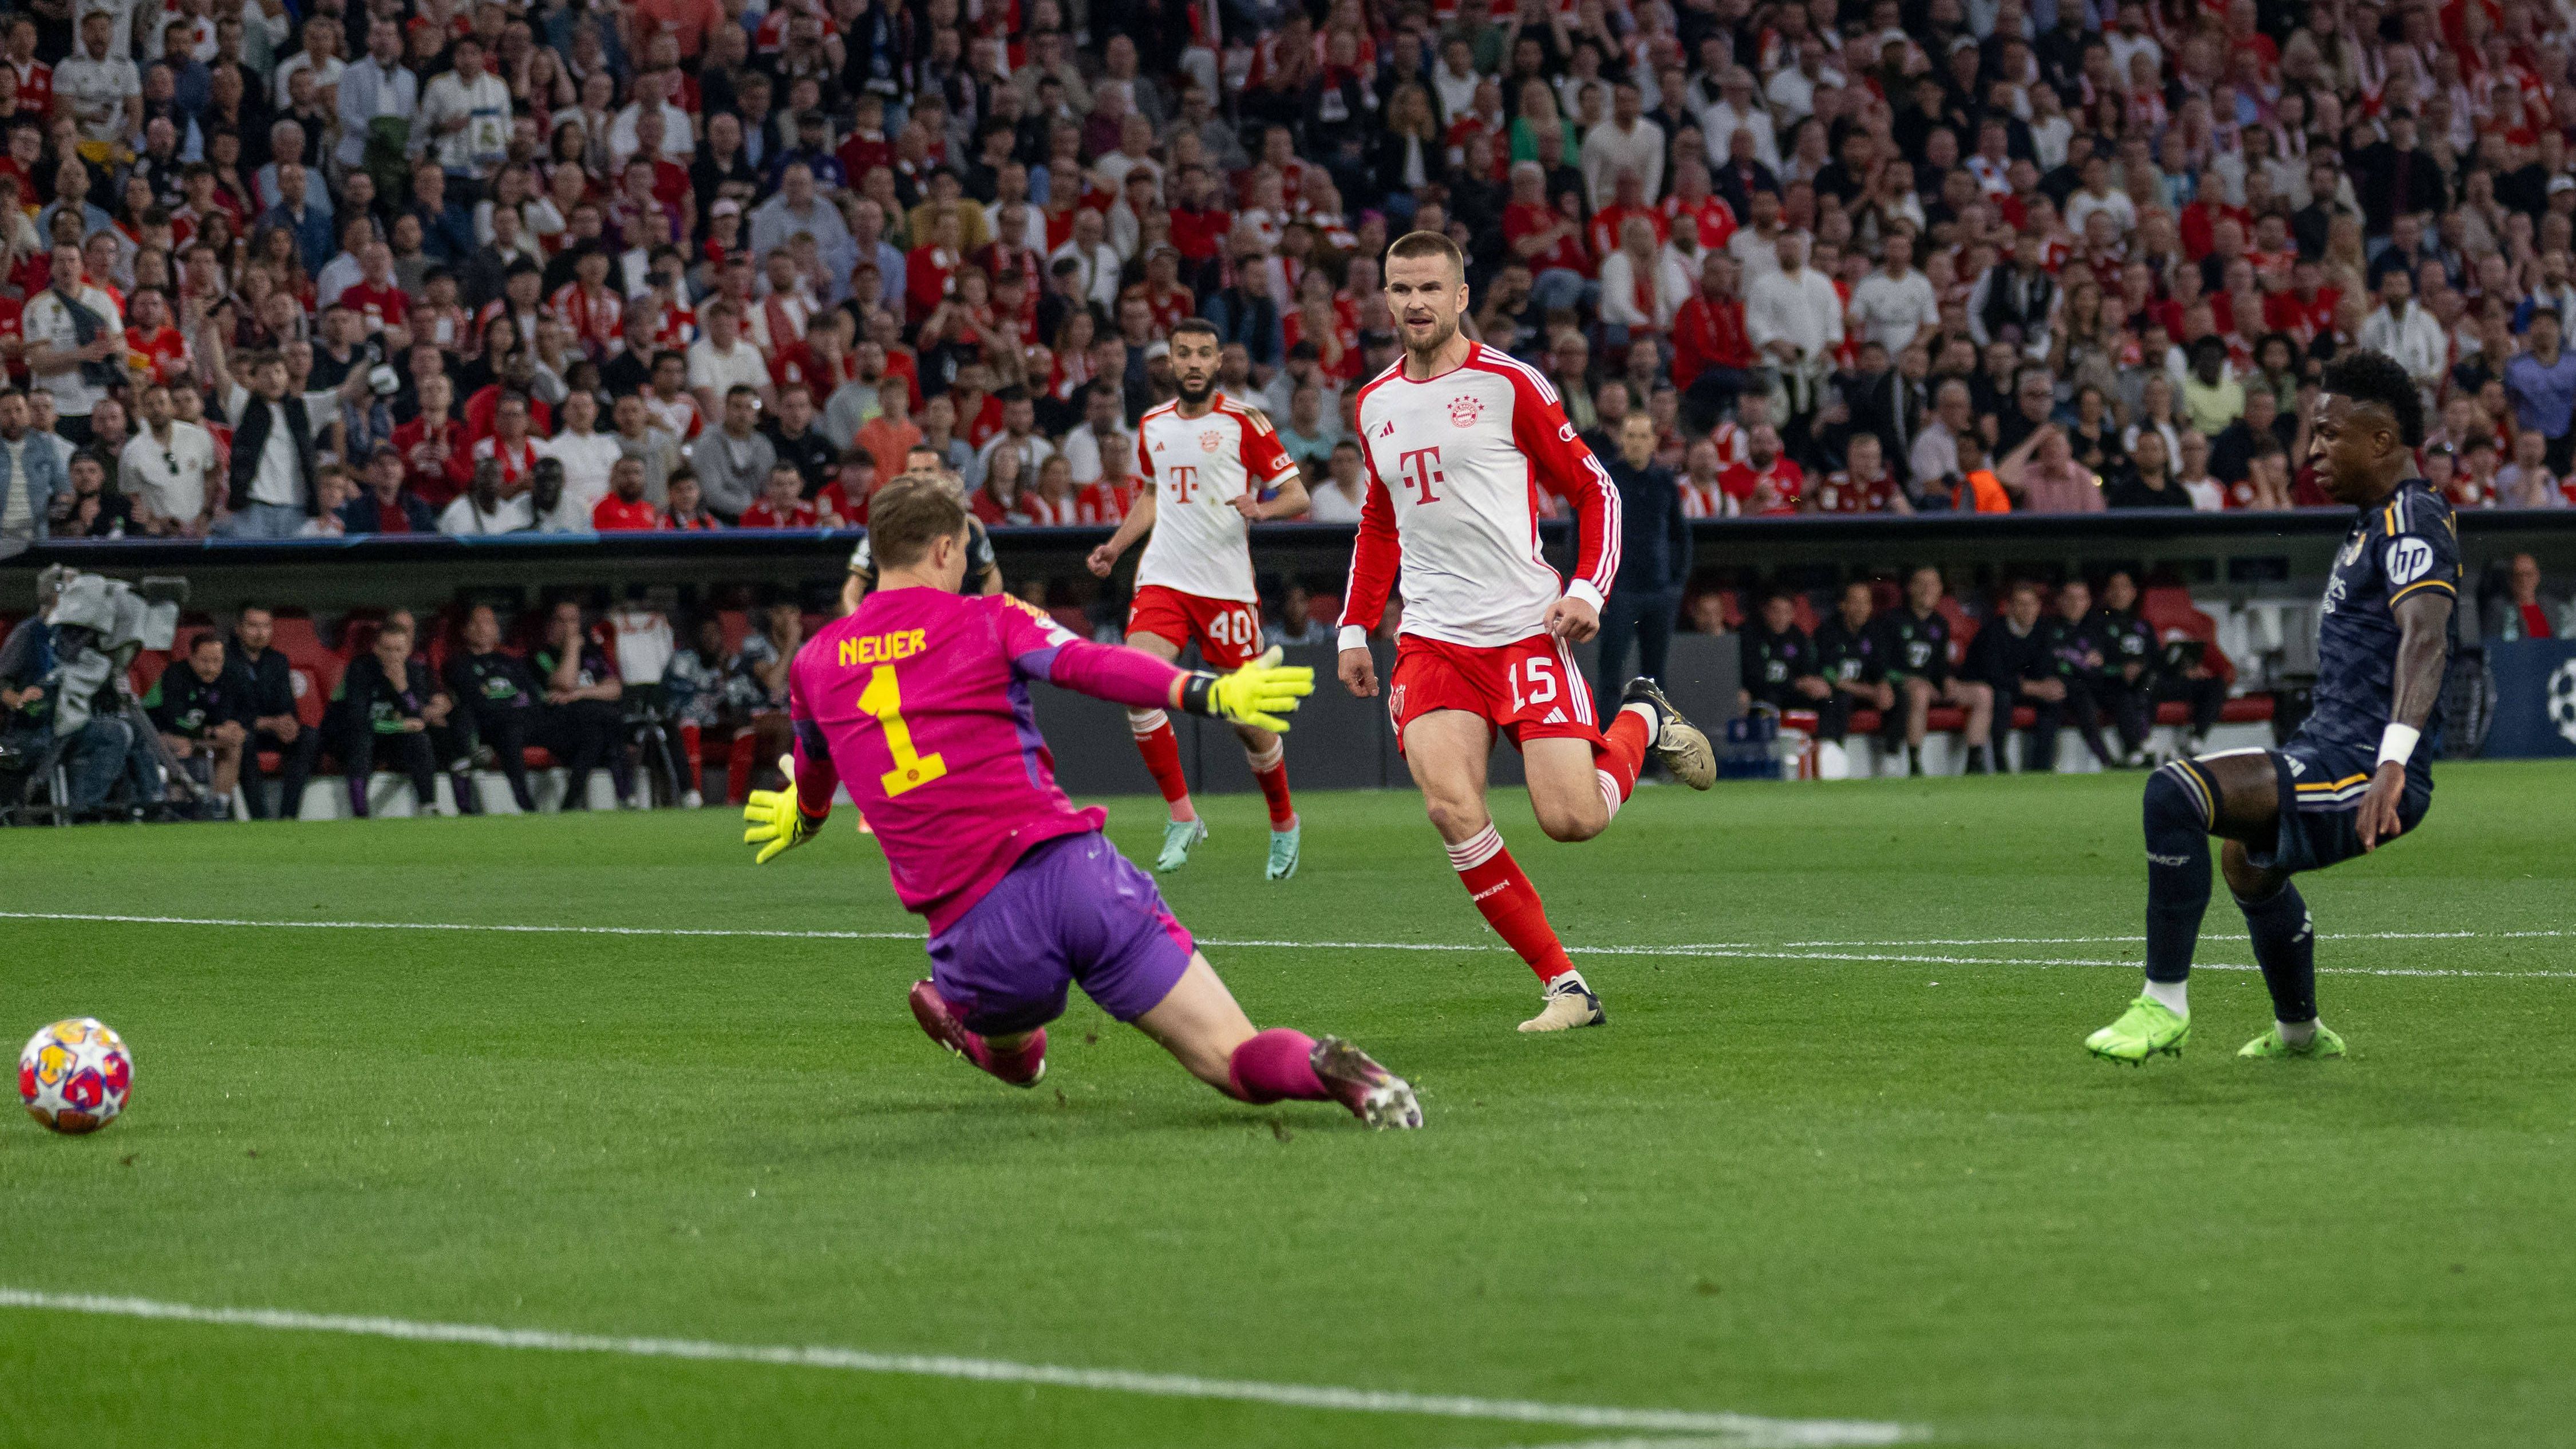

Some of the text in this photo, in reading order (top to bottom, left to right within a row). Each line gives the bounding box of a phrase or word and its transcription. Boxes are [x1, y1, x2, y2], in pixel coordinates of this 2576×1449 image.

[1170, 467, 1198, 504] T
[1400, 446, 1444, 506] T
[2393, 538, 2427, 583] hp
[839, 628, 927, 666] NEUER
[1209, 610, 1252, 646] 40
[1508, 657, 1557, 714] 15
[857, 664, 947, 799] 1
